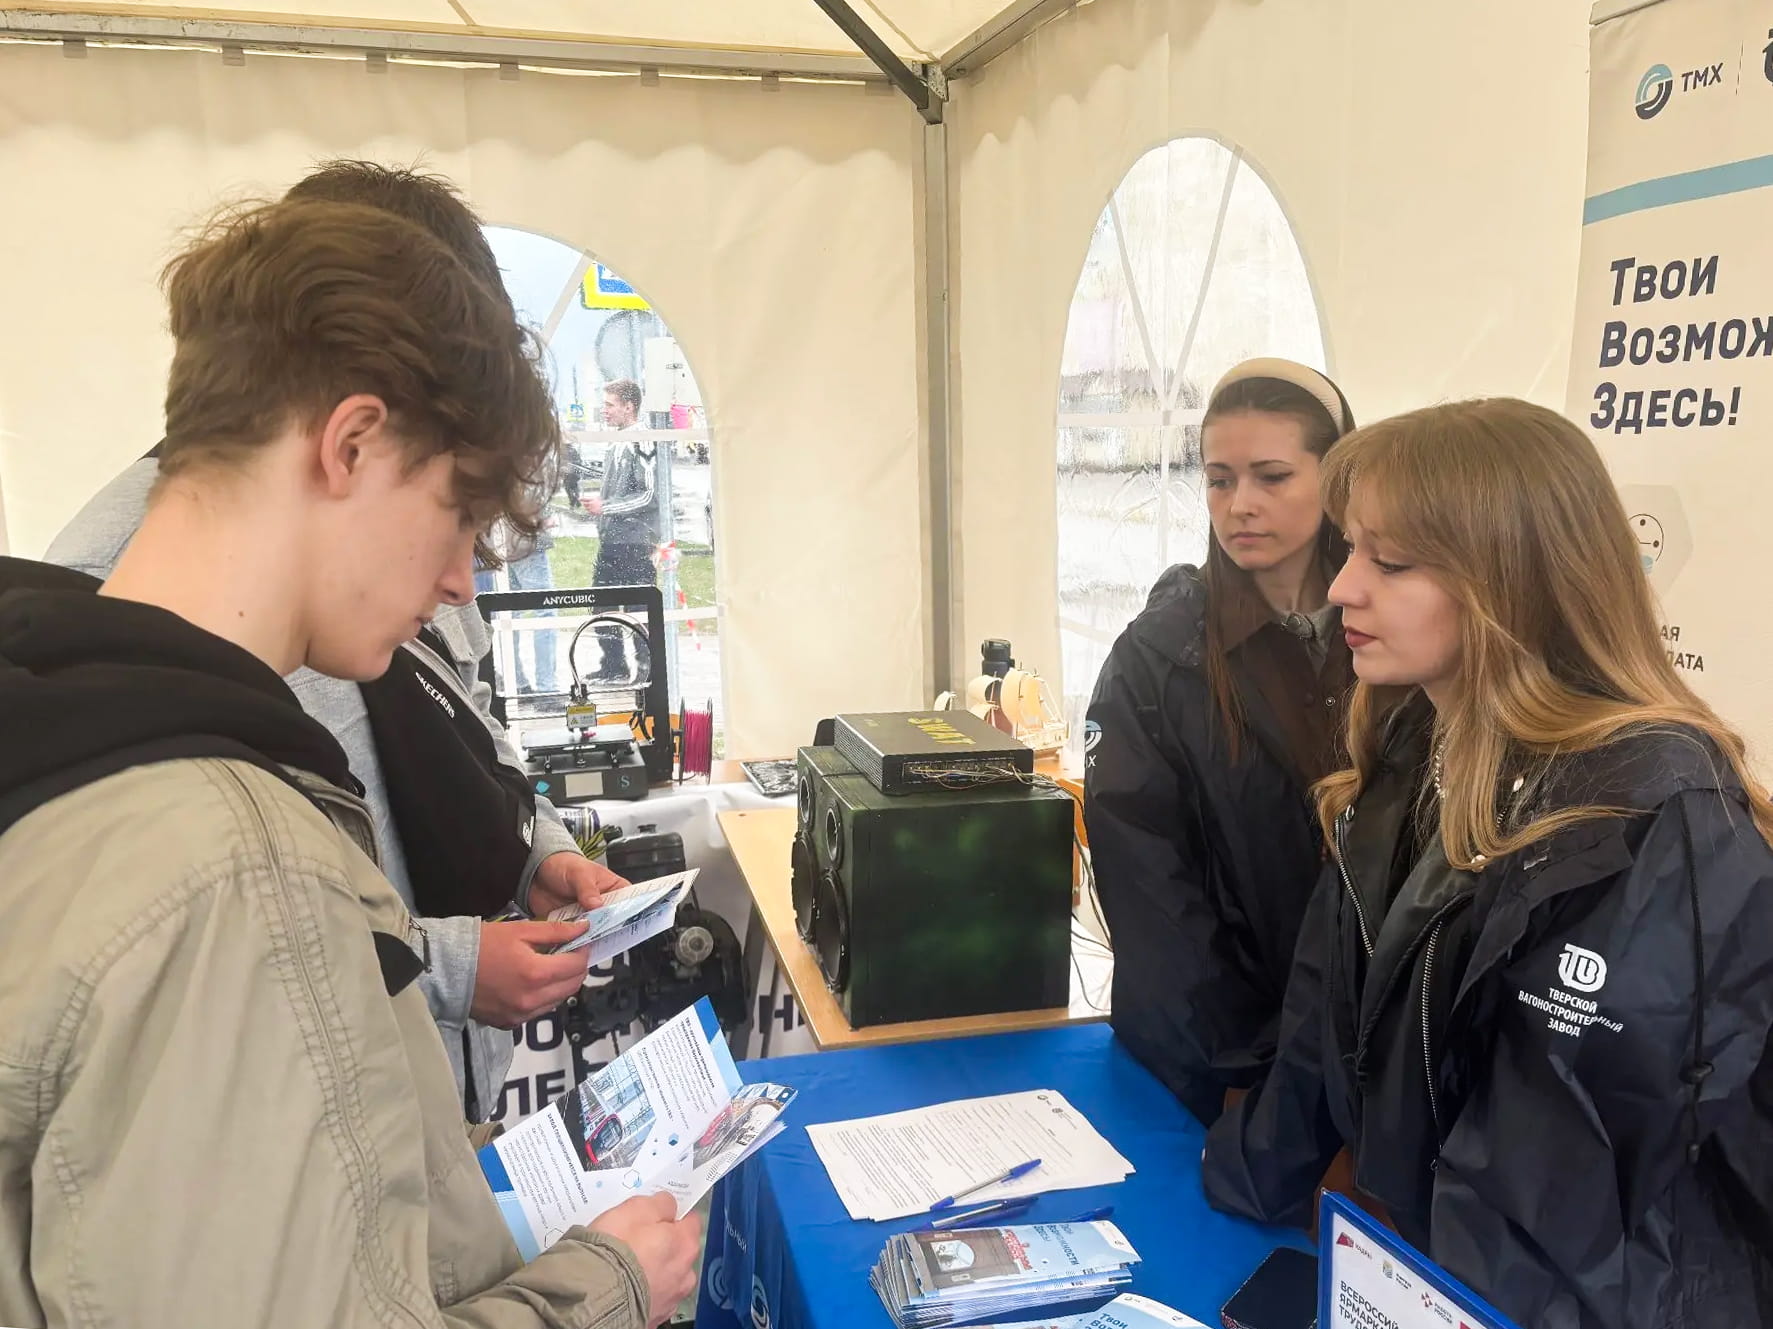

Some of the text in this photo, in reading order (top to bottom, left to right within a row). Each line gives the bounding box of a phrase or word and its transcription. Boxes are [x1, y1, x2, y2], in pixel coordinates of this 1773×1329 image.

[1681, 62, 1724, 92] ТМХ
[543, 594, 596, 606] ANYCUBIC
[1549, 987, 1597, 1013] ТВЕРСКОЙ
[1548, 1017, 1581, 1038] ЗАВОД
[1339, 1293, 1384, 1329] ЯРМАРК
